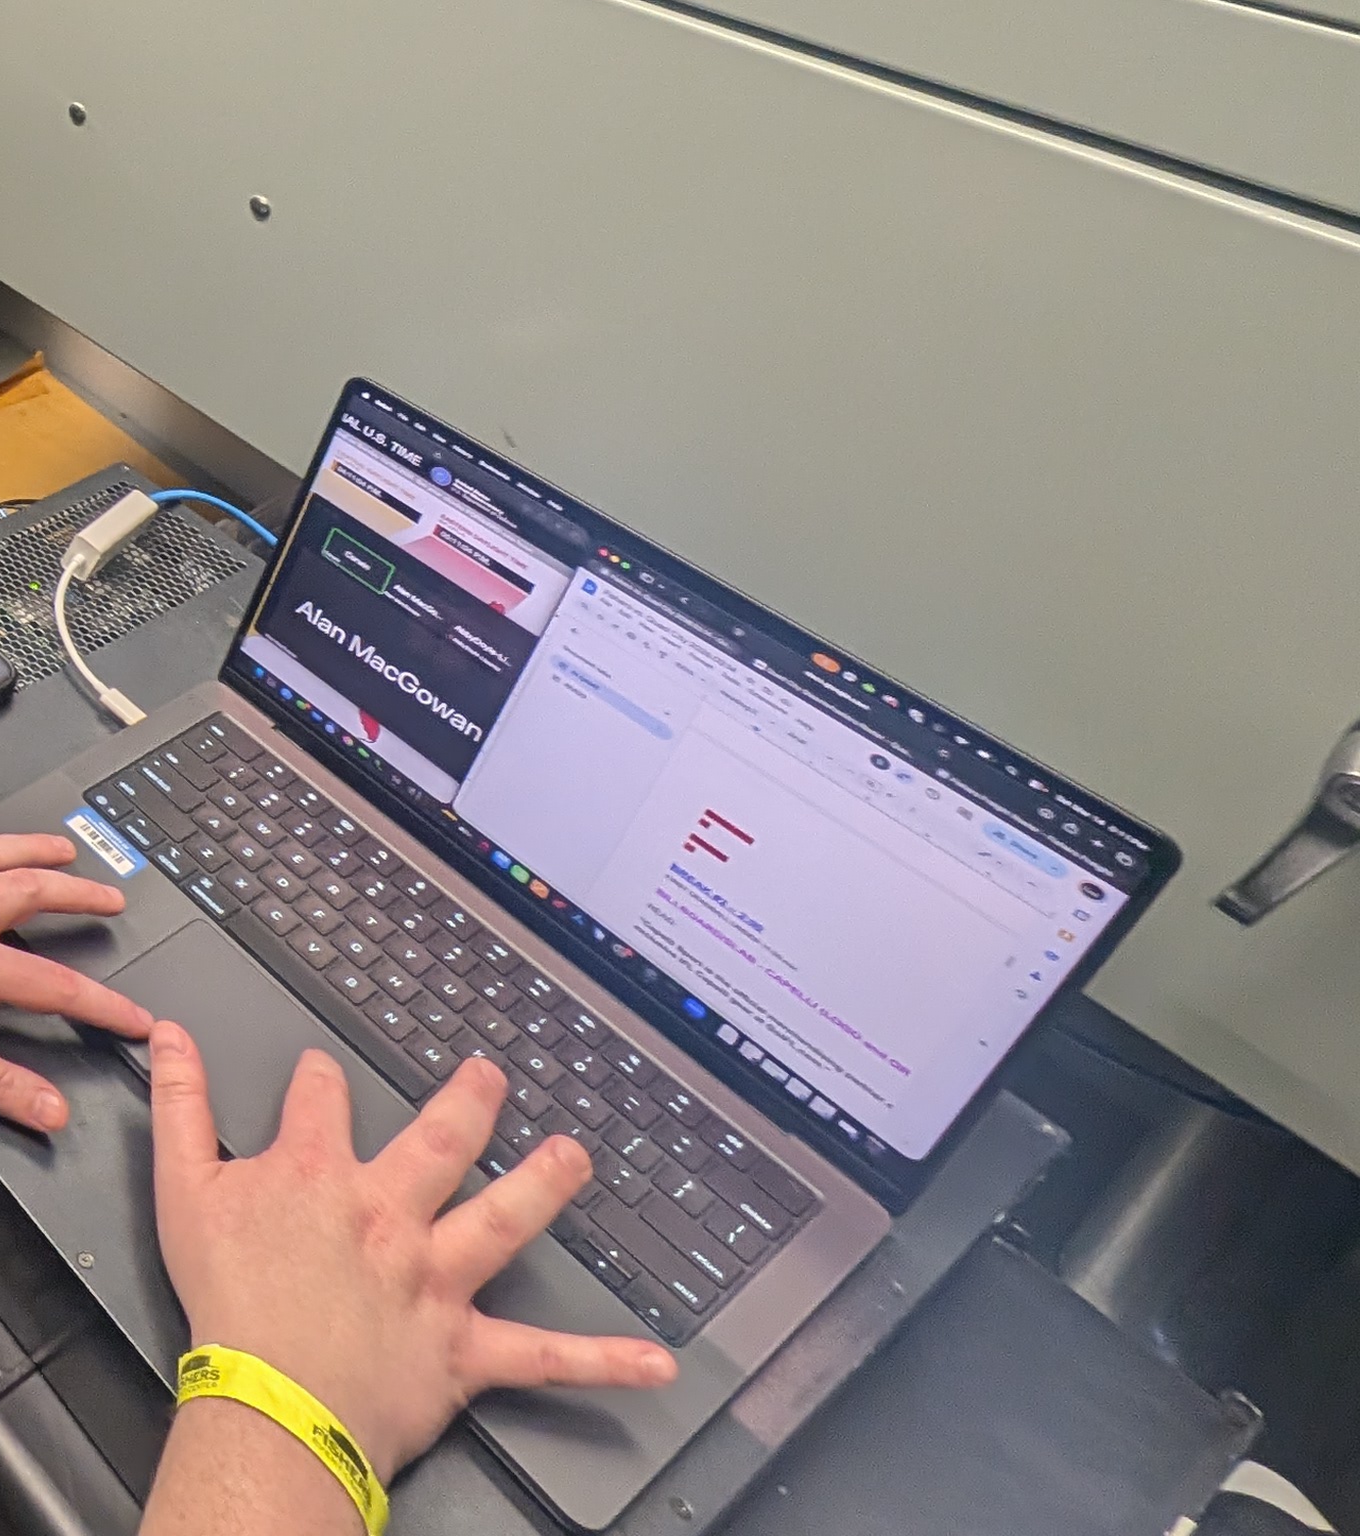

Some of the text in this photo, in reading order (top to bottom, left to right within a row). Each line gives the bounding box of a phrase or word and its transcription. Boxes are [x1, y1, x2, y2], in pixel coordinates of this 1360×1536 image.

[362, 426, 388, 447] U.S.
[389, 440, 423, 467] TIME
[295, 600, 347, 644] Alan
[347, 634, 483, 743] MacGowan
[241, 846, 255, 858] S
[388, 975, 403, 988] H
[443, 983, 457, 996] U
[384, 1011, 399, 1026] N
